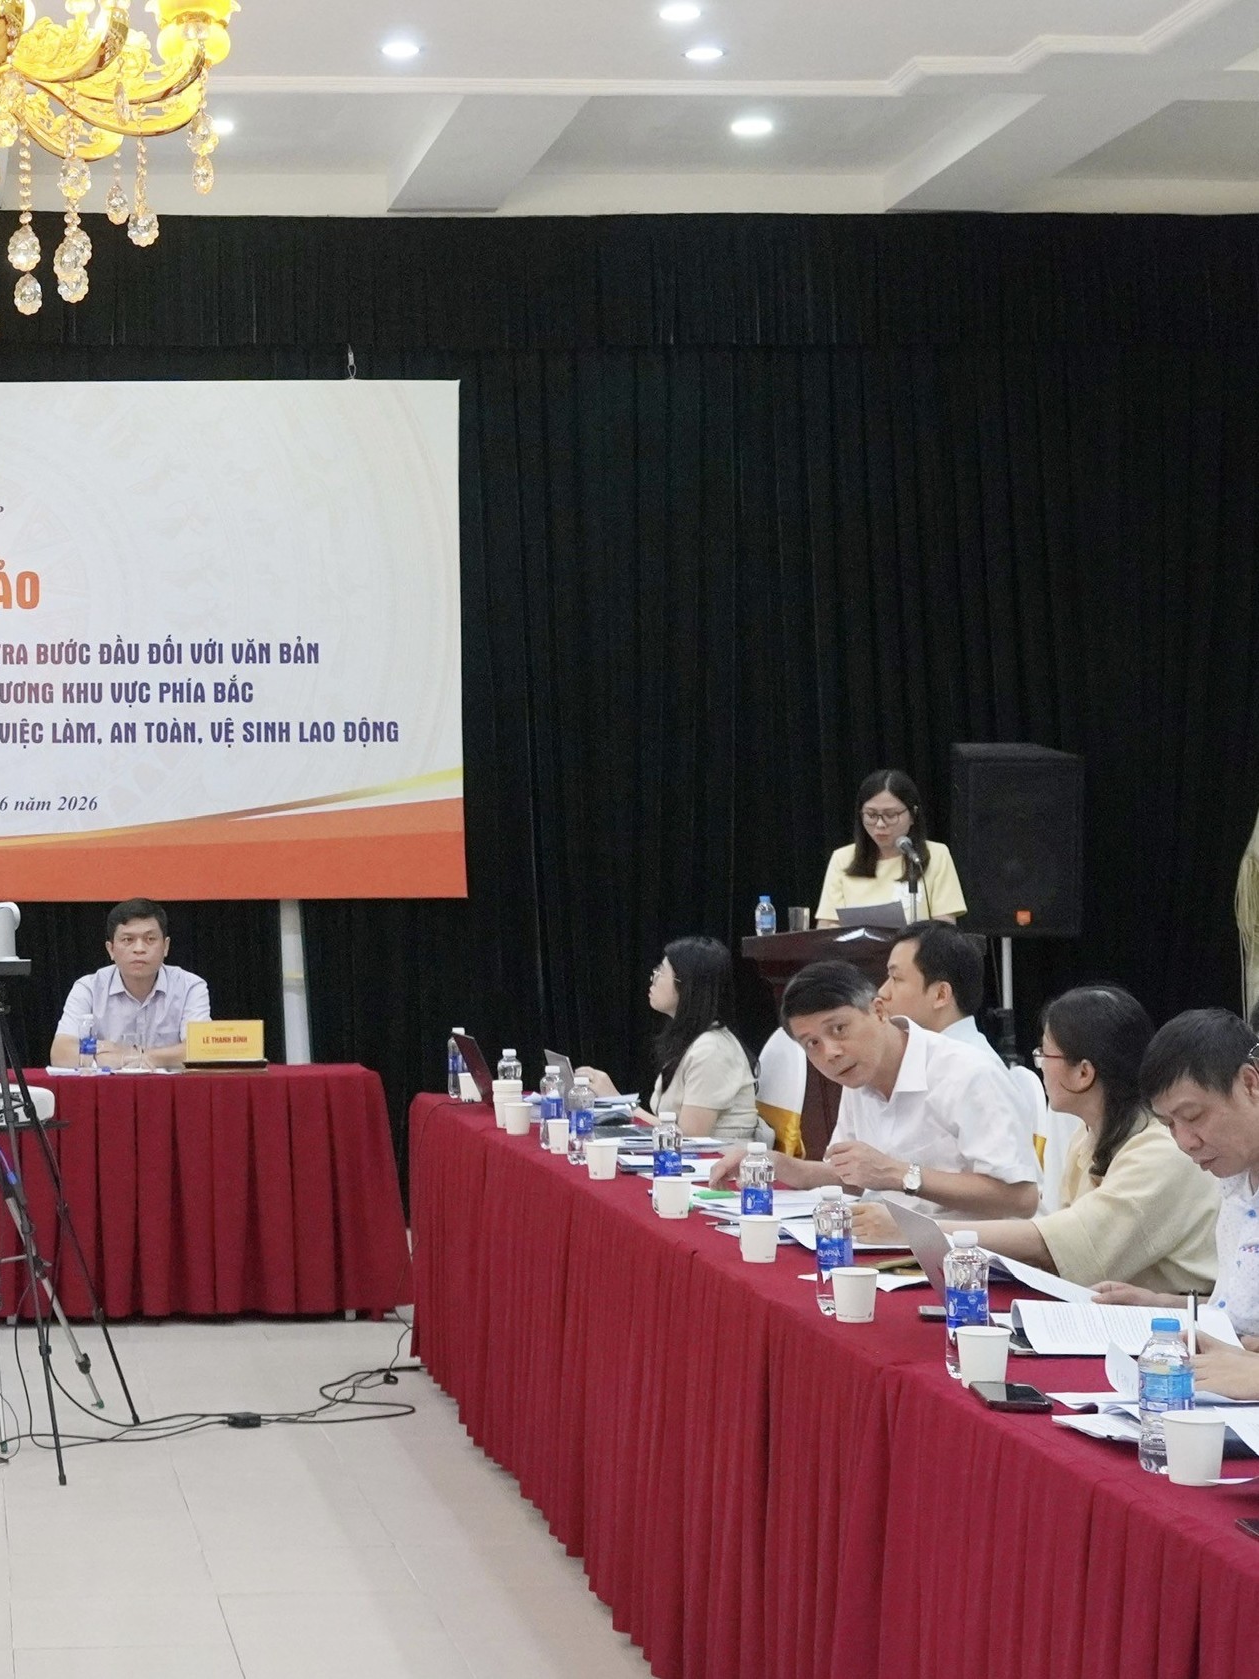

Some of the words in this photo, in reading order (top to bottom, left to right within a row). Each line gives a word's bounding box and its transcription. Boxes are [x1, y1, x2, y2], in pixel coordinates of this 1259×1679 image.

[37, 639, 90, 665] BƯỚC
[98, 635, 139, 665] ĐẦU
[147, 635, 182, 665] ĐỐI
[191, 638, 223, 665] VỚI
[232, 638, 270, 665] VĂN
[279, 635, 319, 665] BẢN
[63, 683, 102, 704] KHU
[111, 681, 150, 709] VỰC
[159, 678, 205, 704] PHÍA
[214, 674, 253, 704] BẮC
[0, 718, 43, 749] VIỆC
[52, 718, 102, 747] LÀM,
[111, 723, 136, 744] AN
[144, 718, 202, 747] TOÀN,
[211, 718, 235, 748] VỆ
[243, 722, 290, 743] SINH
[299, 722, 335, 743] LAO
[343, 717, 399, 748] ĐỘNG
[14, 796, 52, 812] năm
[57, 795, 98, 811] 2026
